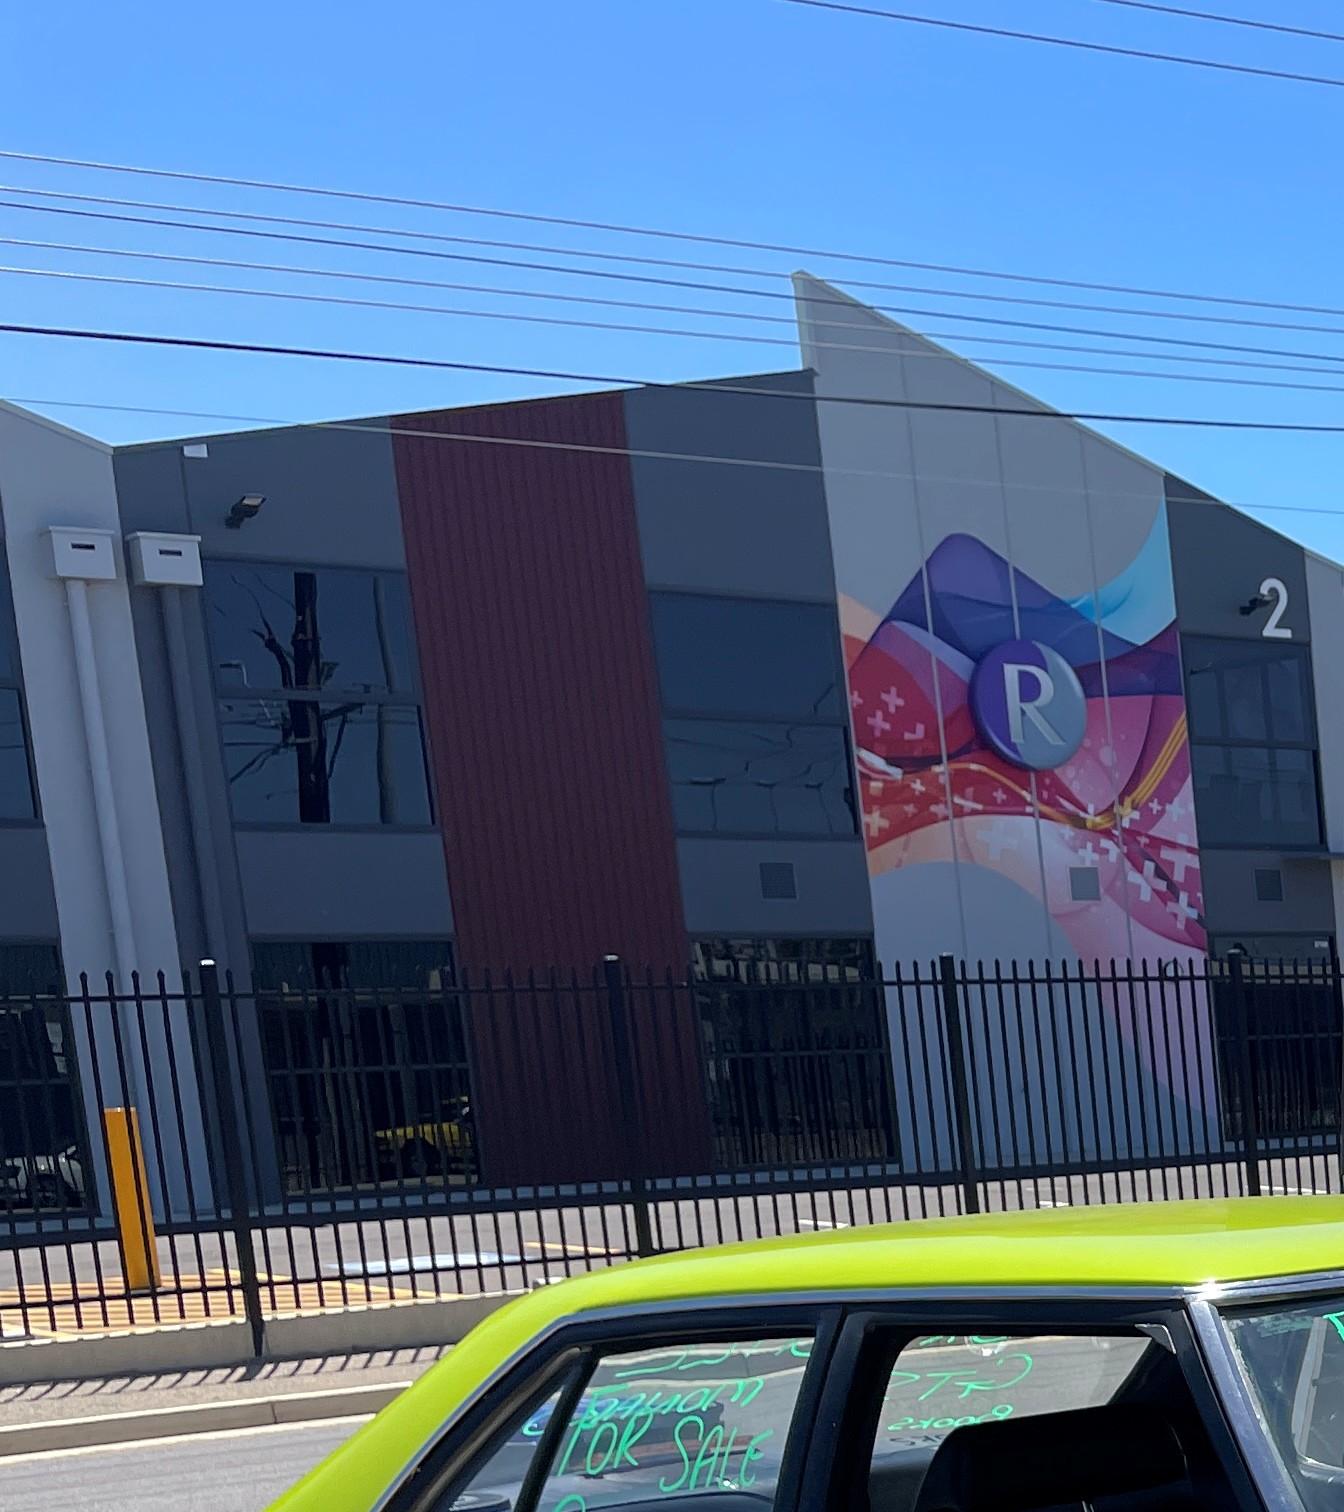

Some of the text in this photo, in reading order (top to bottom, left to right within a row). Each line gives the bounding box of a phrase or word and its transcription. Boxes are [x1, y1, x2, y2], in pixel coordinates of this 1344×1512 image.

[1259, 577, 1292, 639] 2
[1002, 661, 1068, 746] R
[556, 1383, 774, 1493] FOR SALE
